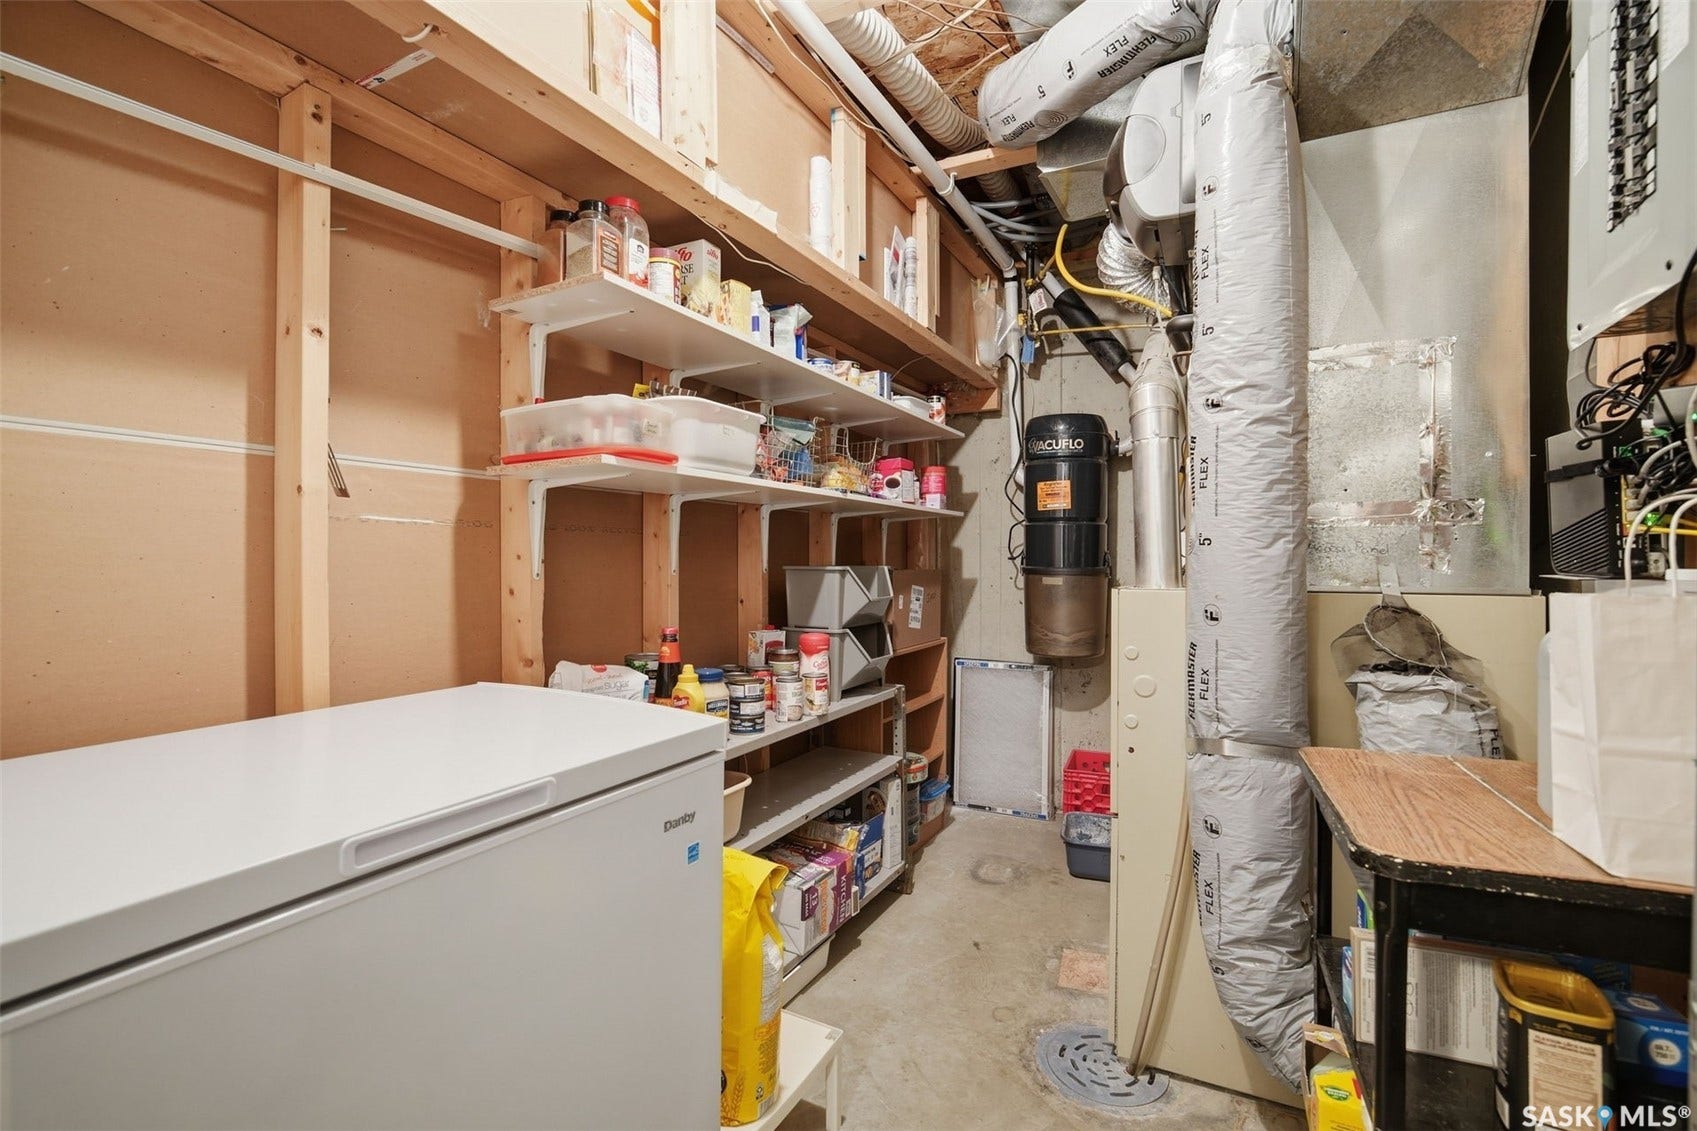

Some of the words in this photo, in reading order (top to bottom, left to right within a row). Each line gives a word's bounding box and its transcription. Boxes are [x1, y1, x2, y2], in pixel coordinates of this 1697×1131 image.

[1102, 35, 1129, 58] FLEX
[1001, 113, 1016, 126] FLEX
[1201, 245, 1210, 280] FLEX
[1032, 438, 1085, 453] VACUFLO
[1199, 456, 1209, 489] FLEX
[1199, 667, 1210, 701] FLEX
[663, 810, 696, 834] Danby
[839, 874, 847, 923] KITCHEN
[1203, 878, 1215, 916] FLEX
